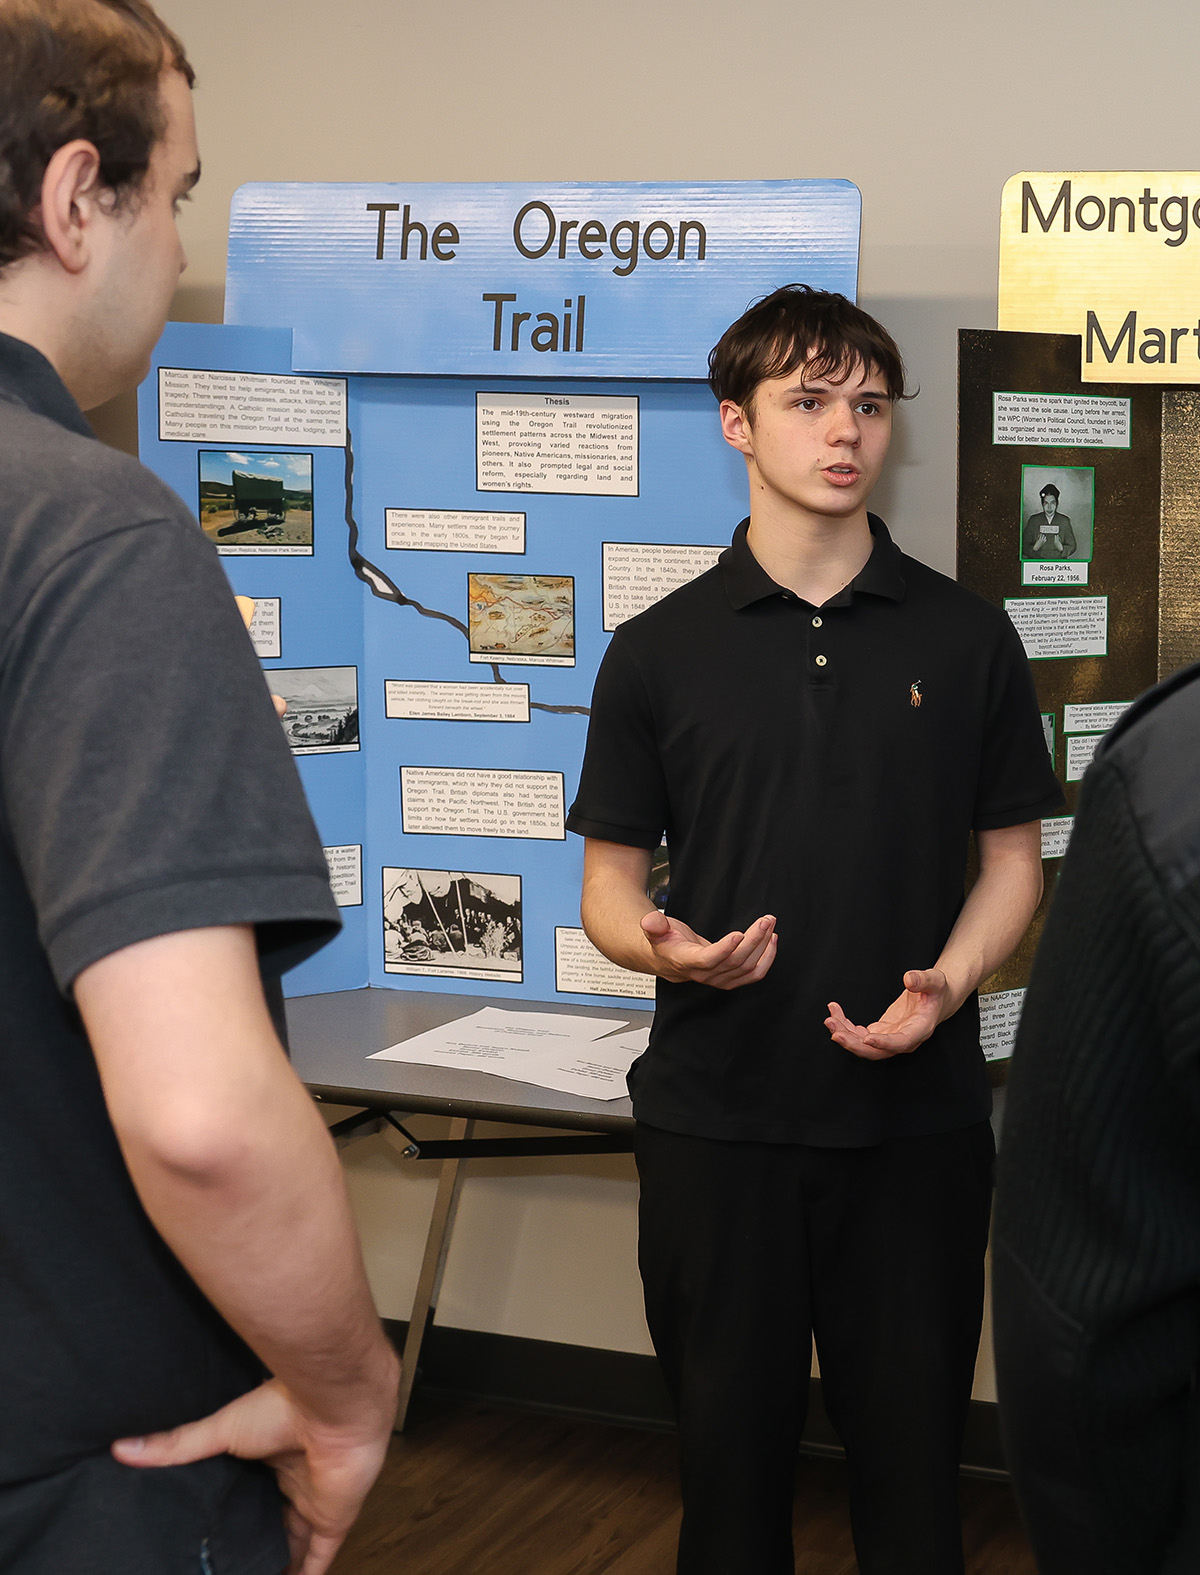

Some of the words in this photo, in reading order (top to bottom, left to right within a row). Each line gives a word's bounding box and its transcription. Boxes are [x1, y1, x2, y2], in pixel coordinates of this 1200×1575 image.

[366, 203, 460, 261] The
[513, 200, 707, 277] Oregon
[482, 292, 586, 353] Trail
[1049, 397, 1062, 406] spark
[1074, 398, 1090, 407] ignited
[501, 410, 556, 419] mid-19th-century
[601, 412, 633, 421] migration
[1071, 408, 1083, 416] Long
[482, 420, 500, 428] using
[529, 421, 553, 430] Oregon
[586, 422, 632, 430] revolutionized
[520, 431, 546, 440] patterns
[482, 440, 500, 448] West,
[508, 441, 541, 450] provoking
[578, 442, 609, 450] reactions
[482, 450, 512, 459] pioneers,
[536, 452, 573, 460] Americans,
[574, 453, 618, 461] missionaries,
[540, 462, 572, 471] prompted
[576, 463, 592, 471] legal
[514, 472, 547, 480] especially
[556, 473, 588, 481] regarding
[513, 481, 533, 490] rights.
[642, 547, 661, 555] people
[1032, 575, 1056, 583] February
